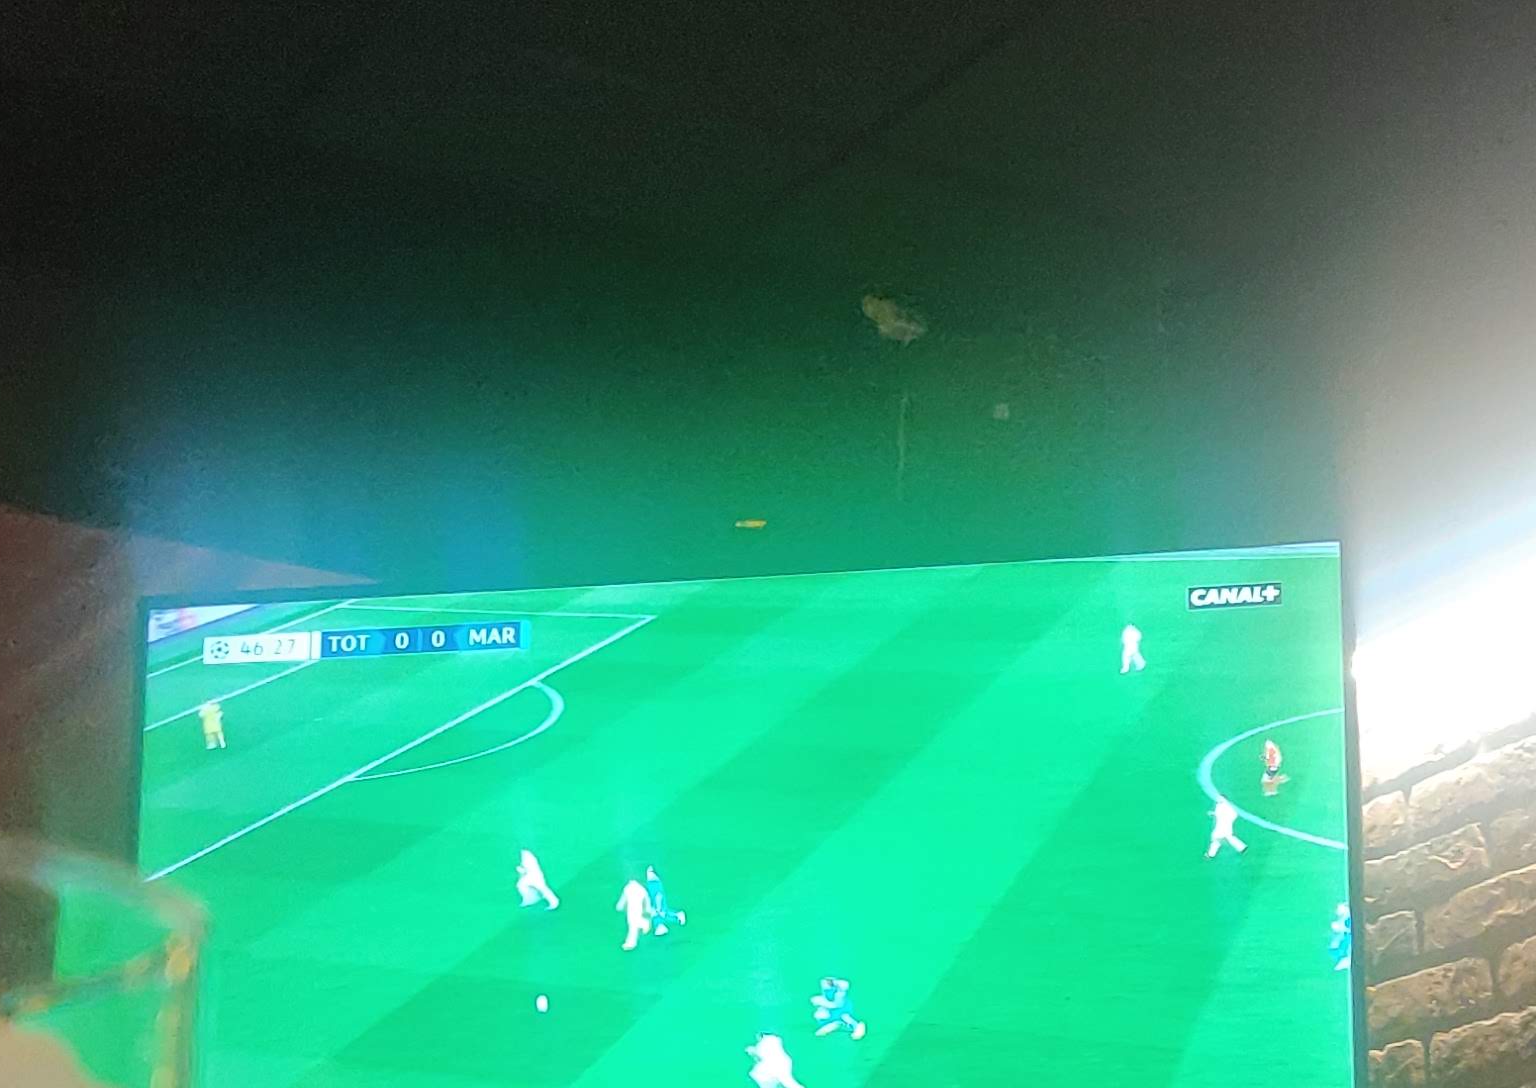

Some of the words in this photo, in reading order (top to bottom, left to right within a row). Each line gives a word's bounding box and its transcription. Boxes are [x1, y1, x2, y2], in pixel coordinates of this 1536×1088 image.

[1190, 584, 1281, 607] CANAL+
[327, 634, 371, 653] TOT
[394, 631, 410, 650] 0
[431, 629, 446, 648] 0
[468, 626, 516, 646] MAR
